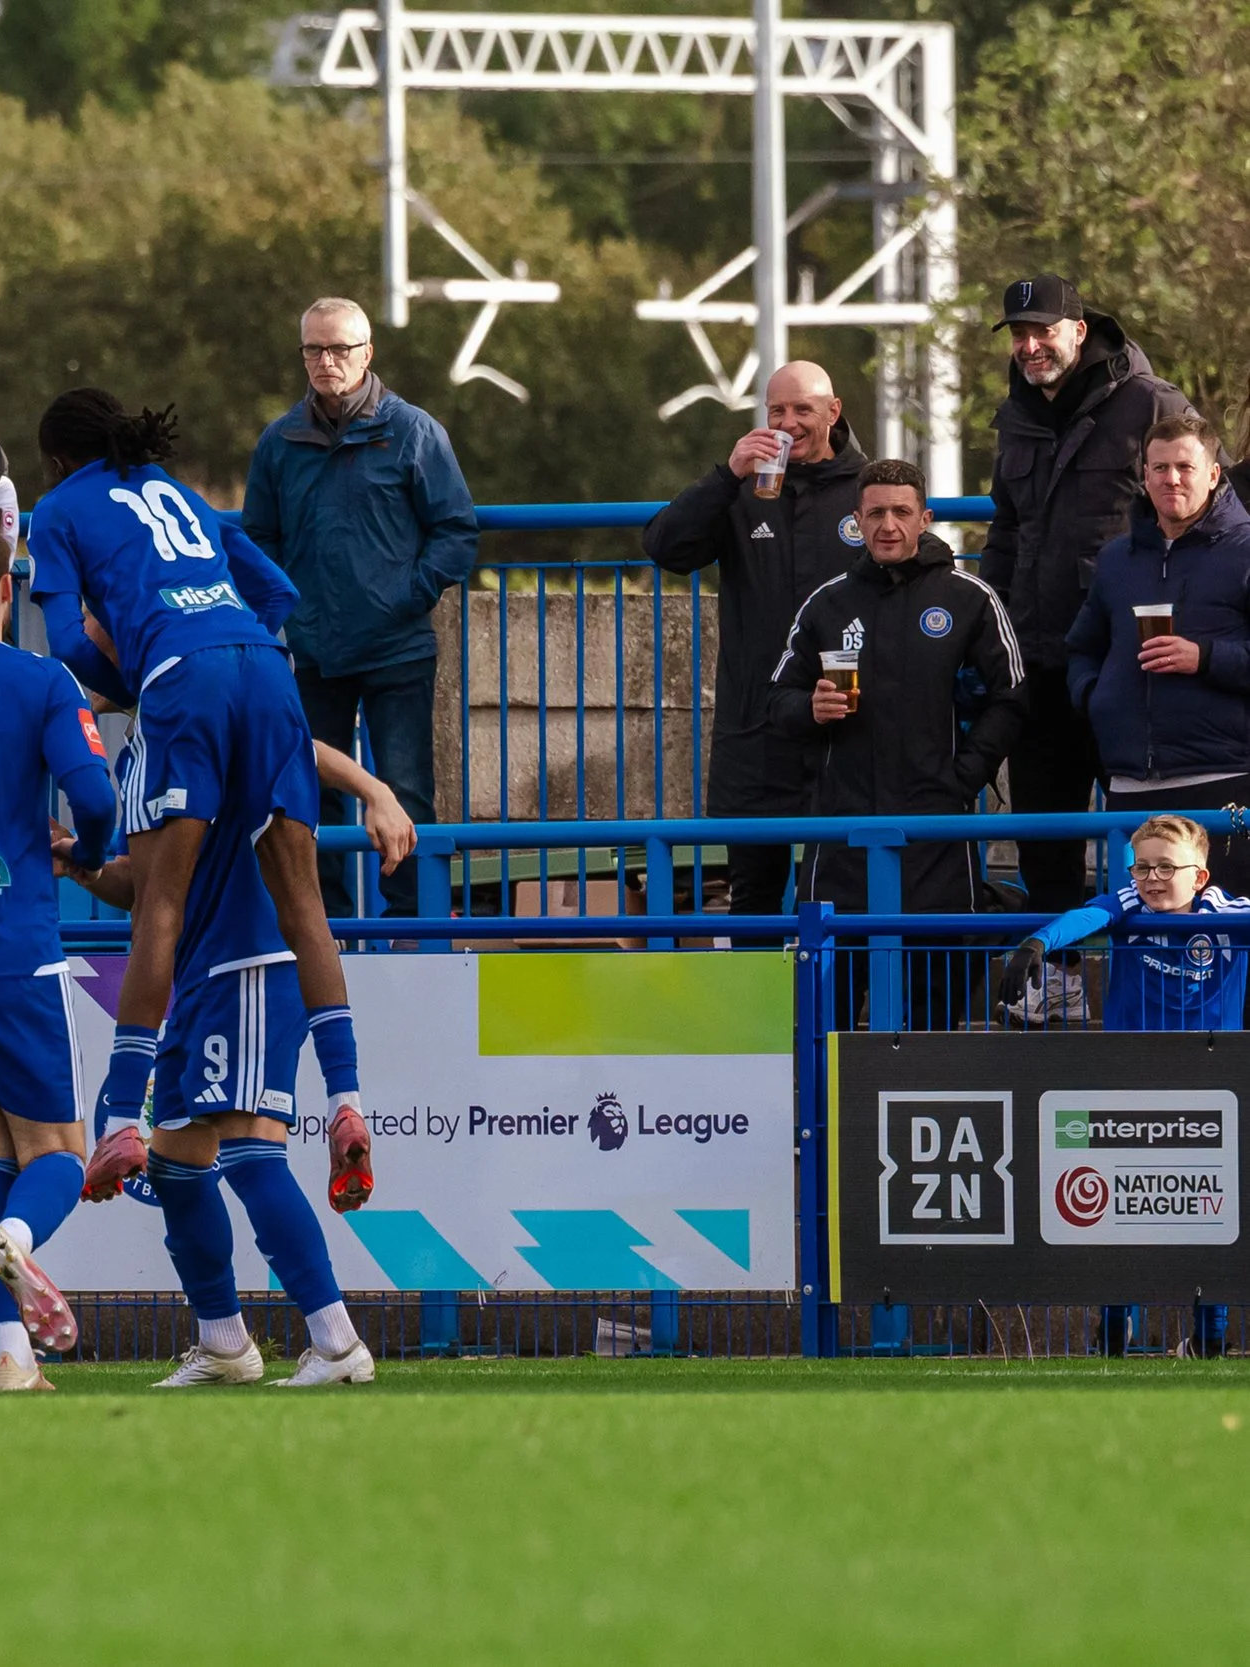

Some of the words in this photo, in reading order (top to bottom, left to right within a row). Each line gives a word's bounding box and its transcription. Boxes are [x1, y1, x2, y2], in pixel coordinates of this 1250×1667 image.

[109, 480, 216, 562] 10
[842, 632, 863, 650] DS
[203, 1034, 228, 1082] 9
[426, 1106, 461, 1144] by
[469, 1105, 580, 1136] Premier
[638, 1105, 749, 1144] League
[1065, 1117, 1220, 1144] enterprise
[1114, 1174, 1224, 1194] NATIONAL
